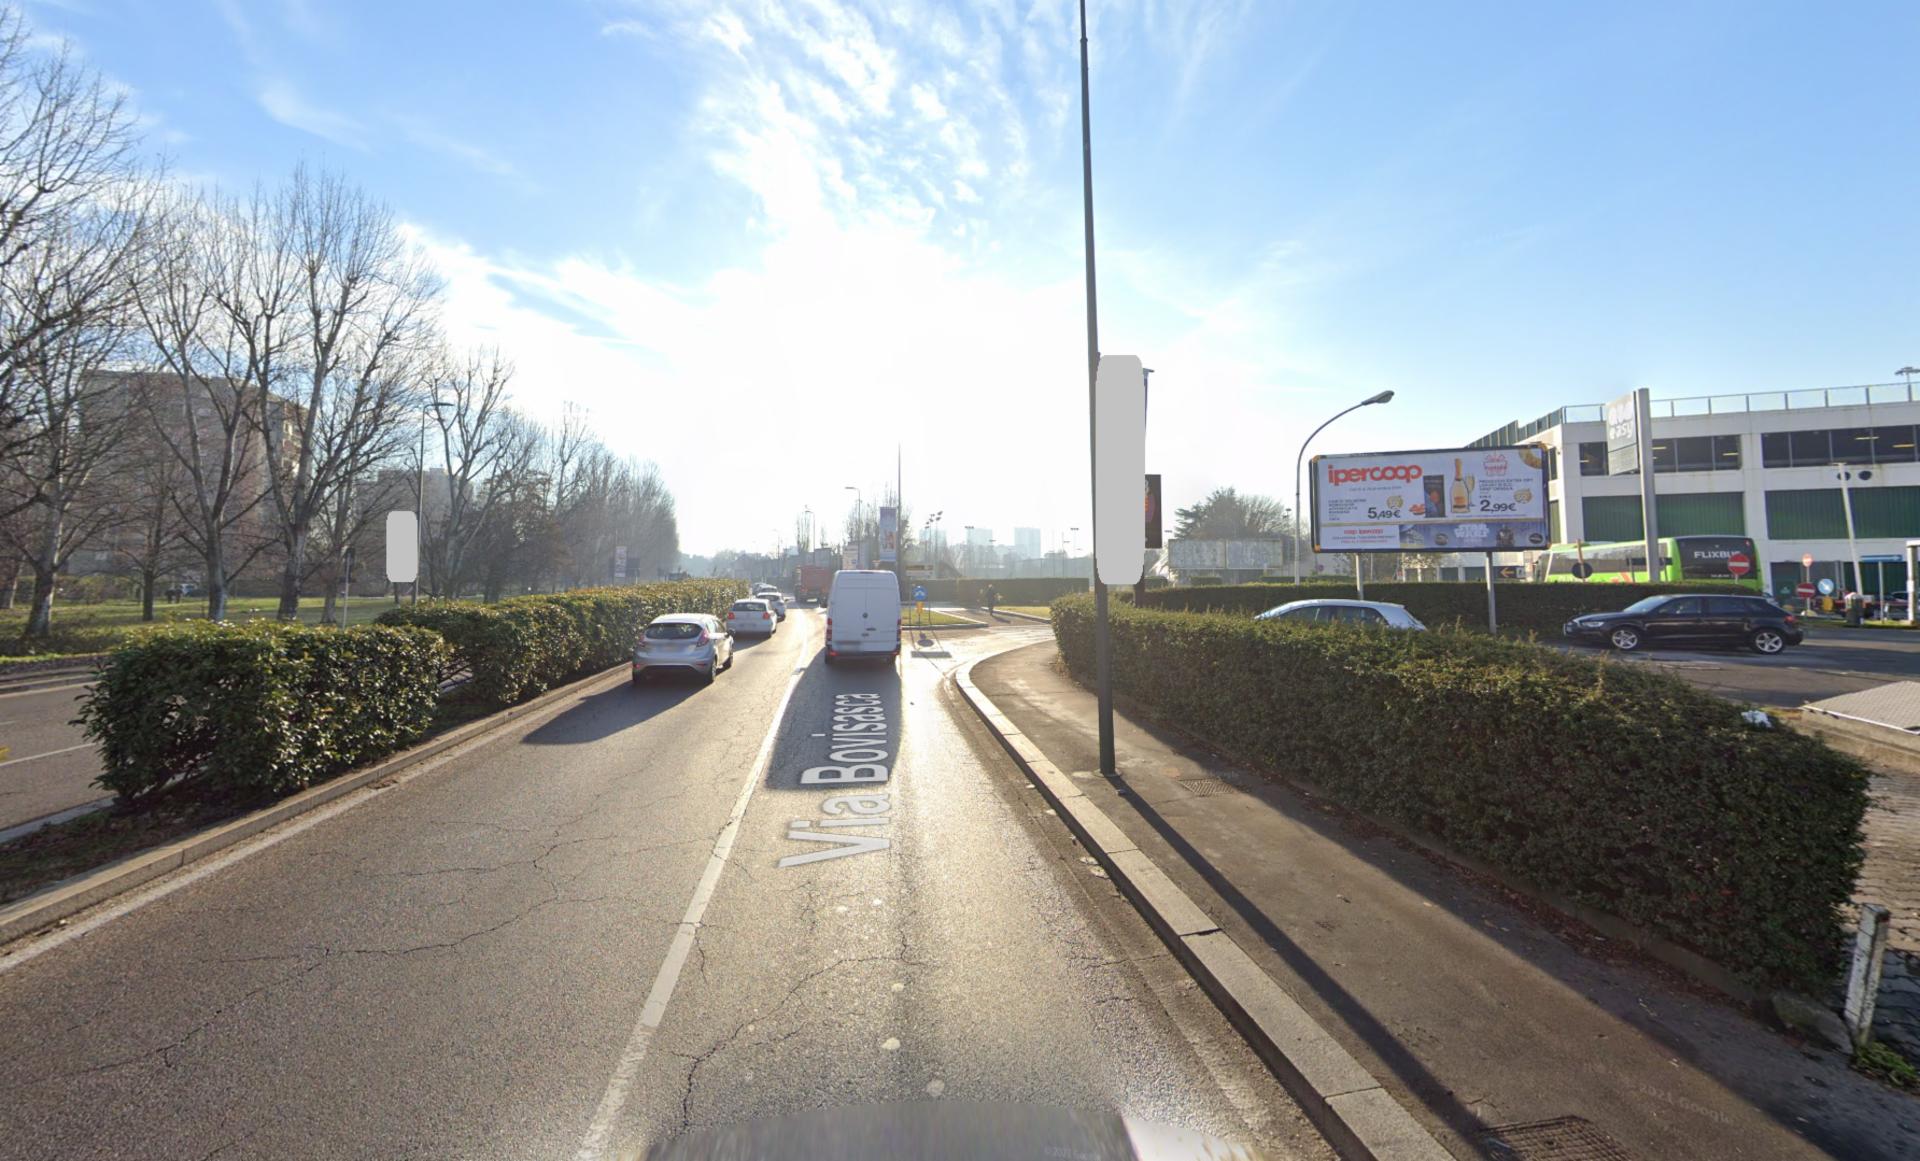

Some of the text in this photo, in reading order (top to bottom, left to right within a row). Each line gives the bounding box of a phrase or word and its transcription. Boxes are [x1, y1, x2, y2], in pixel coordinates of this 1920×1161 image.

[1327, 464, 1423, 486] ipercoop
[1367, 506, 1401, 520] 5,49€
[1479, 499, 1517, 513] 2,99€
